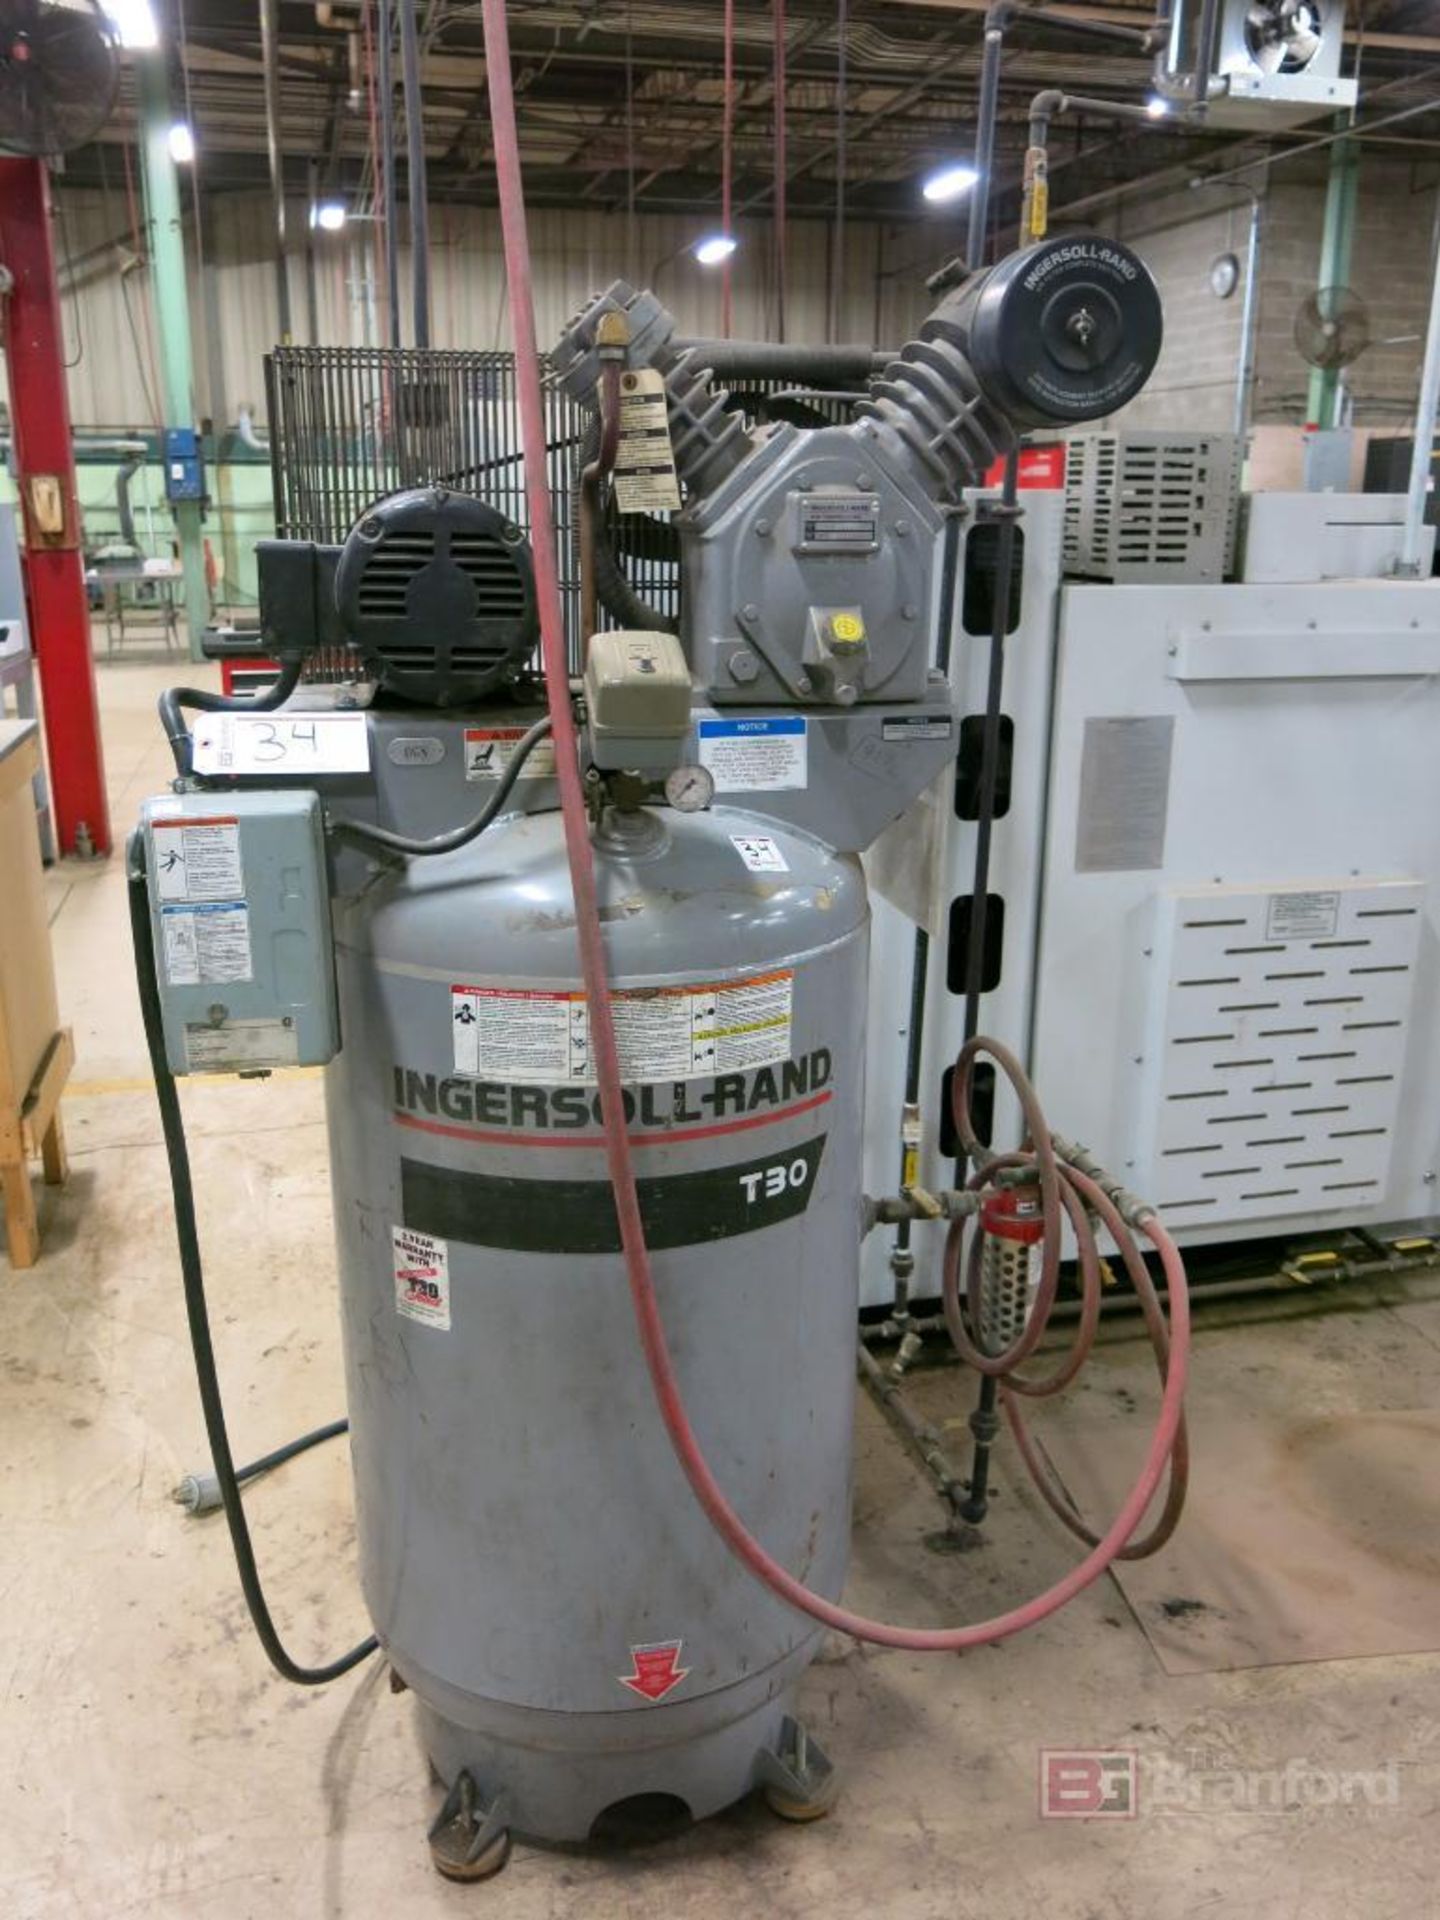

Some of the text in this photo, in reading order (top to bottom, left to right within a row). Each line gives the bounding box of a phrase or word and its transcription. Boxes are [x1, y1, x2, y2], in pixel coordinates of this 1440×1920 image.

[1023, 243, 1138, 291] INGERSOLL-RAND
[250, 722, 318, 762] 34
[393, 1048, 831, 1128] INGERSOLL-RAND
[739, 1158, 808, 1204] T30
